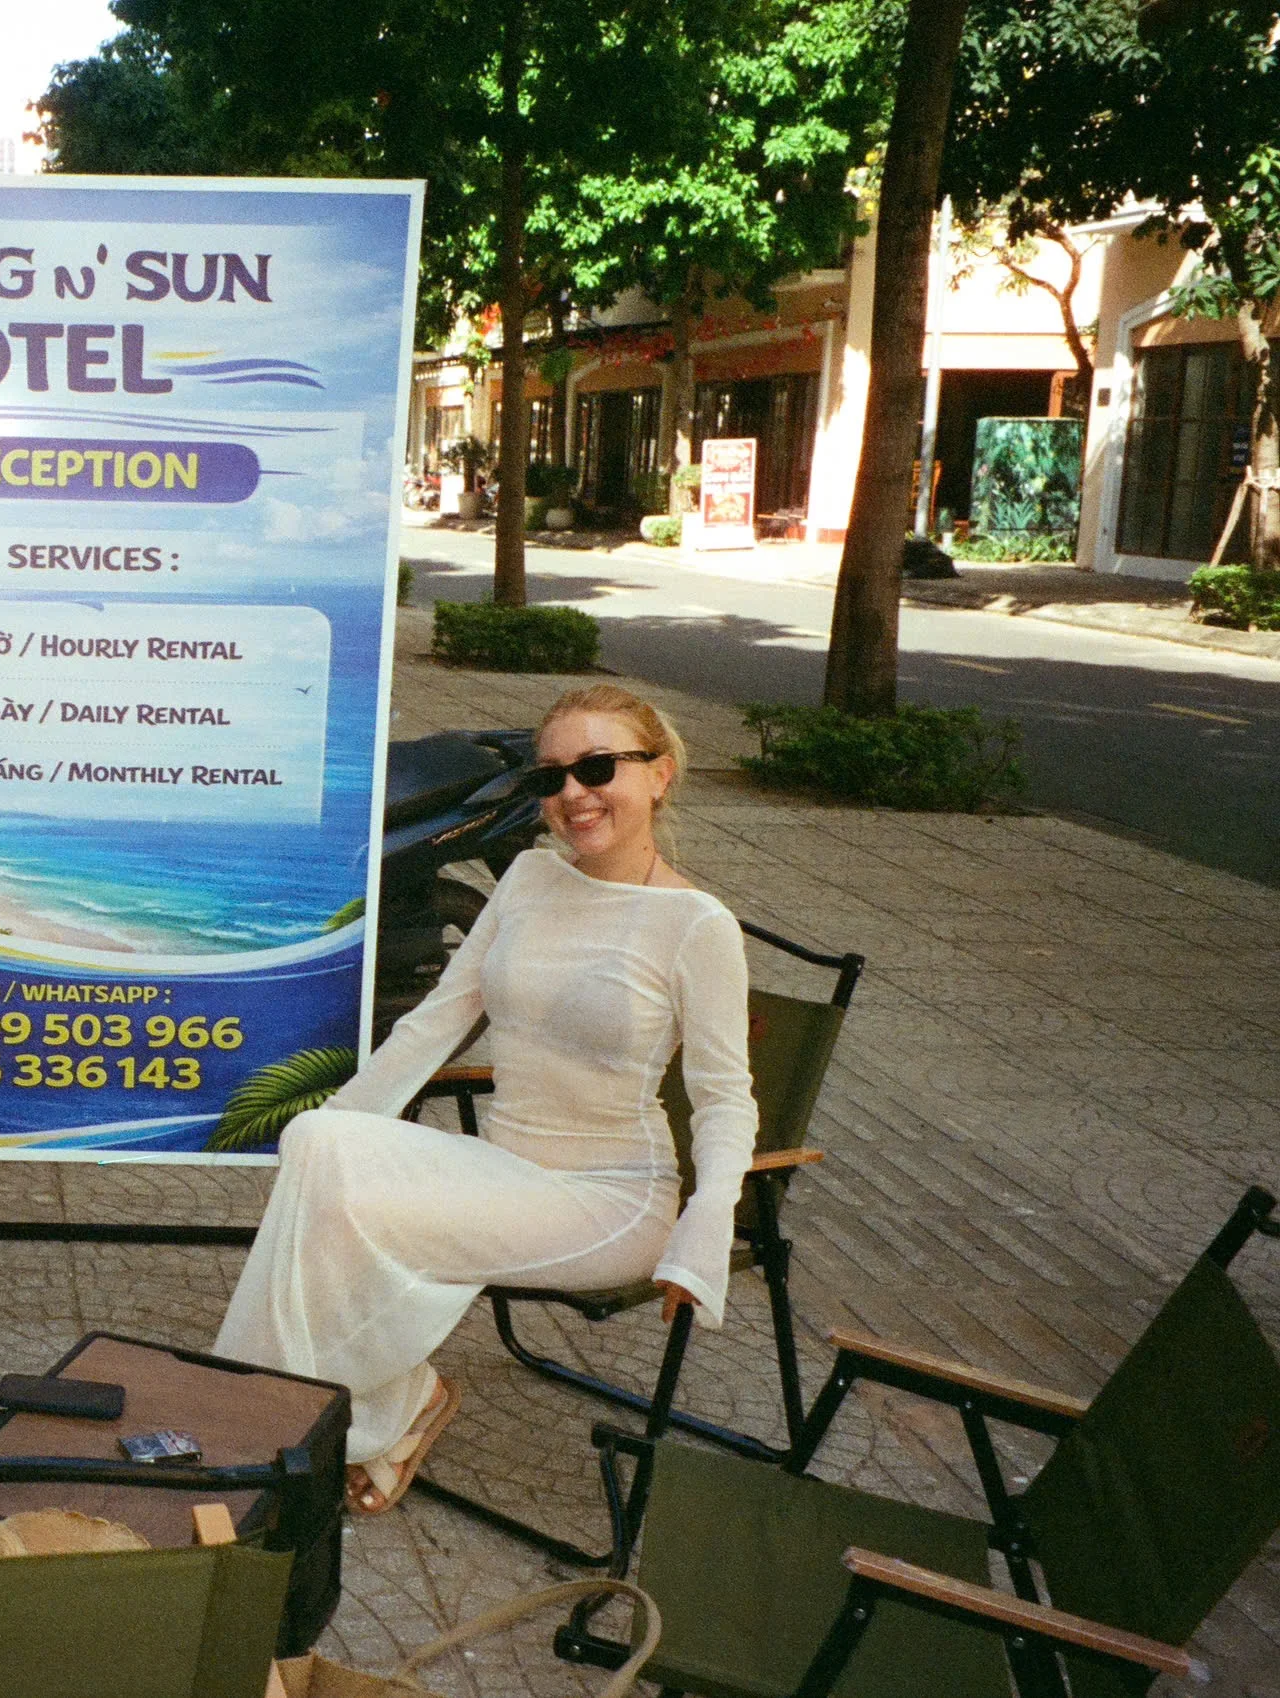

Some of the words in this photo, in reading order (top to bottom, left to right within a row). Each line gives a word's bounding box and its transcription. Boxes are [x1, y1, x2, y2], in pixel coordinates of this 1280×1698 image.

[126, 251, 272, 302] SUN
[8, 544, 162, 571] SERVICES
[19, 633, 34, 657] /
[39, 700, 54, 724] /
[49, 761, 63, 783] /
[3, 981, 16, 1002] /
[22, 984, 158, 1003] WHATSAPP
[43, 1014, 132, 1046] 503
[146, 1016, 243, 1049] 966
[14, 1055, 107, 1088] 336
[118, 1057, 200, 1089] 143
